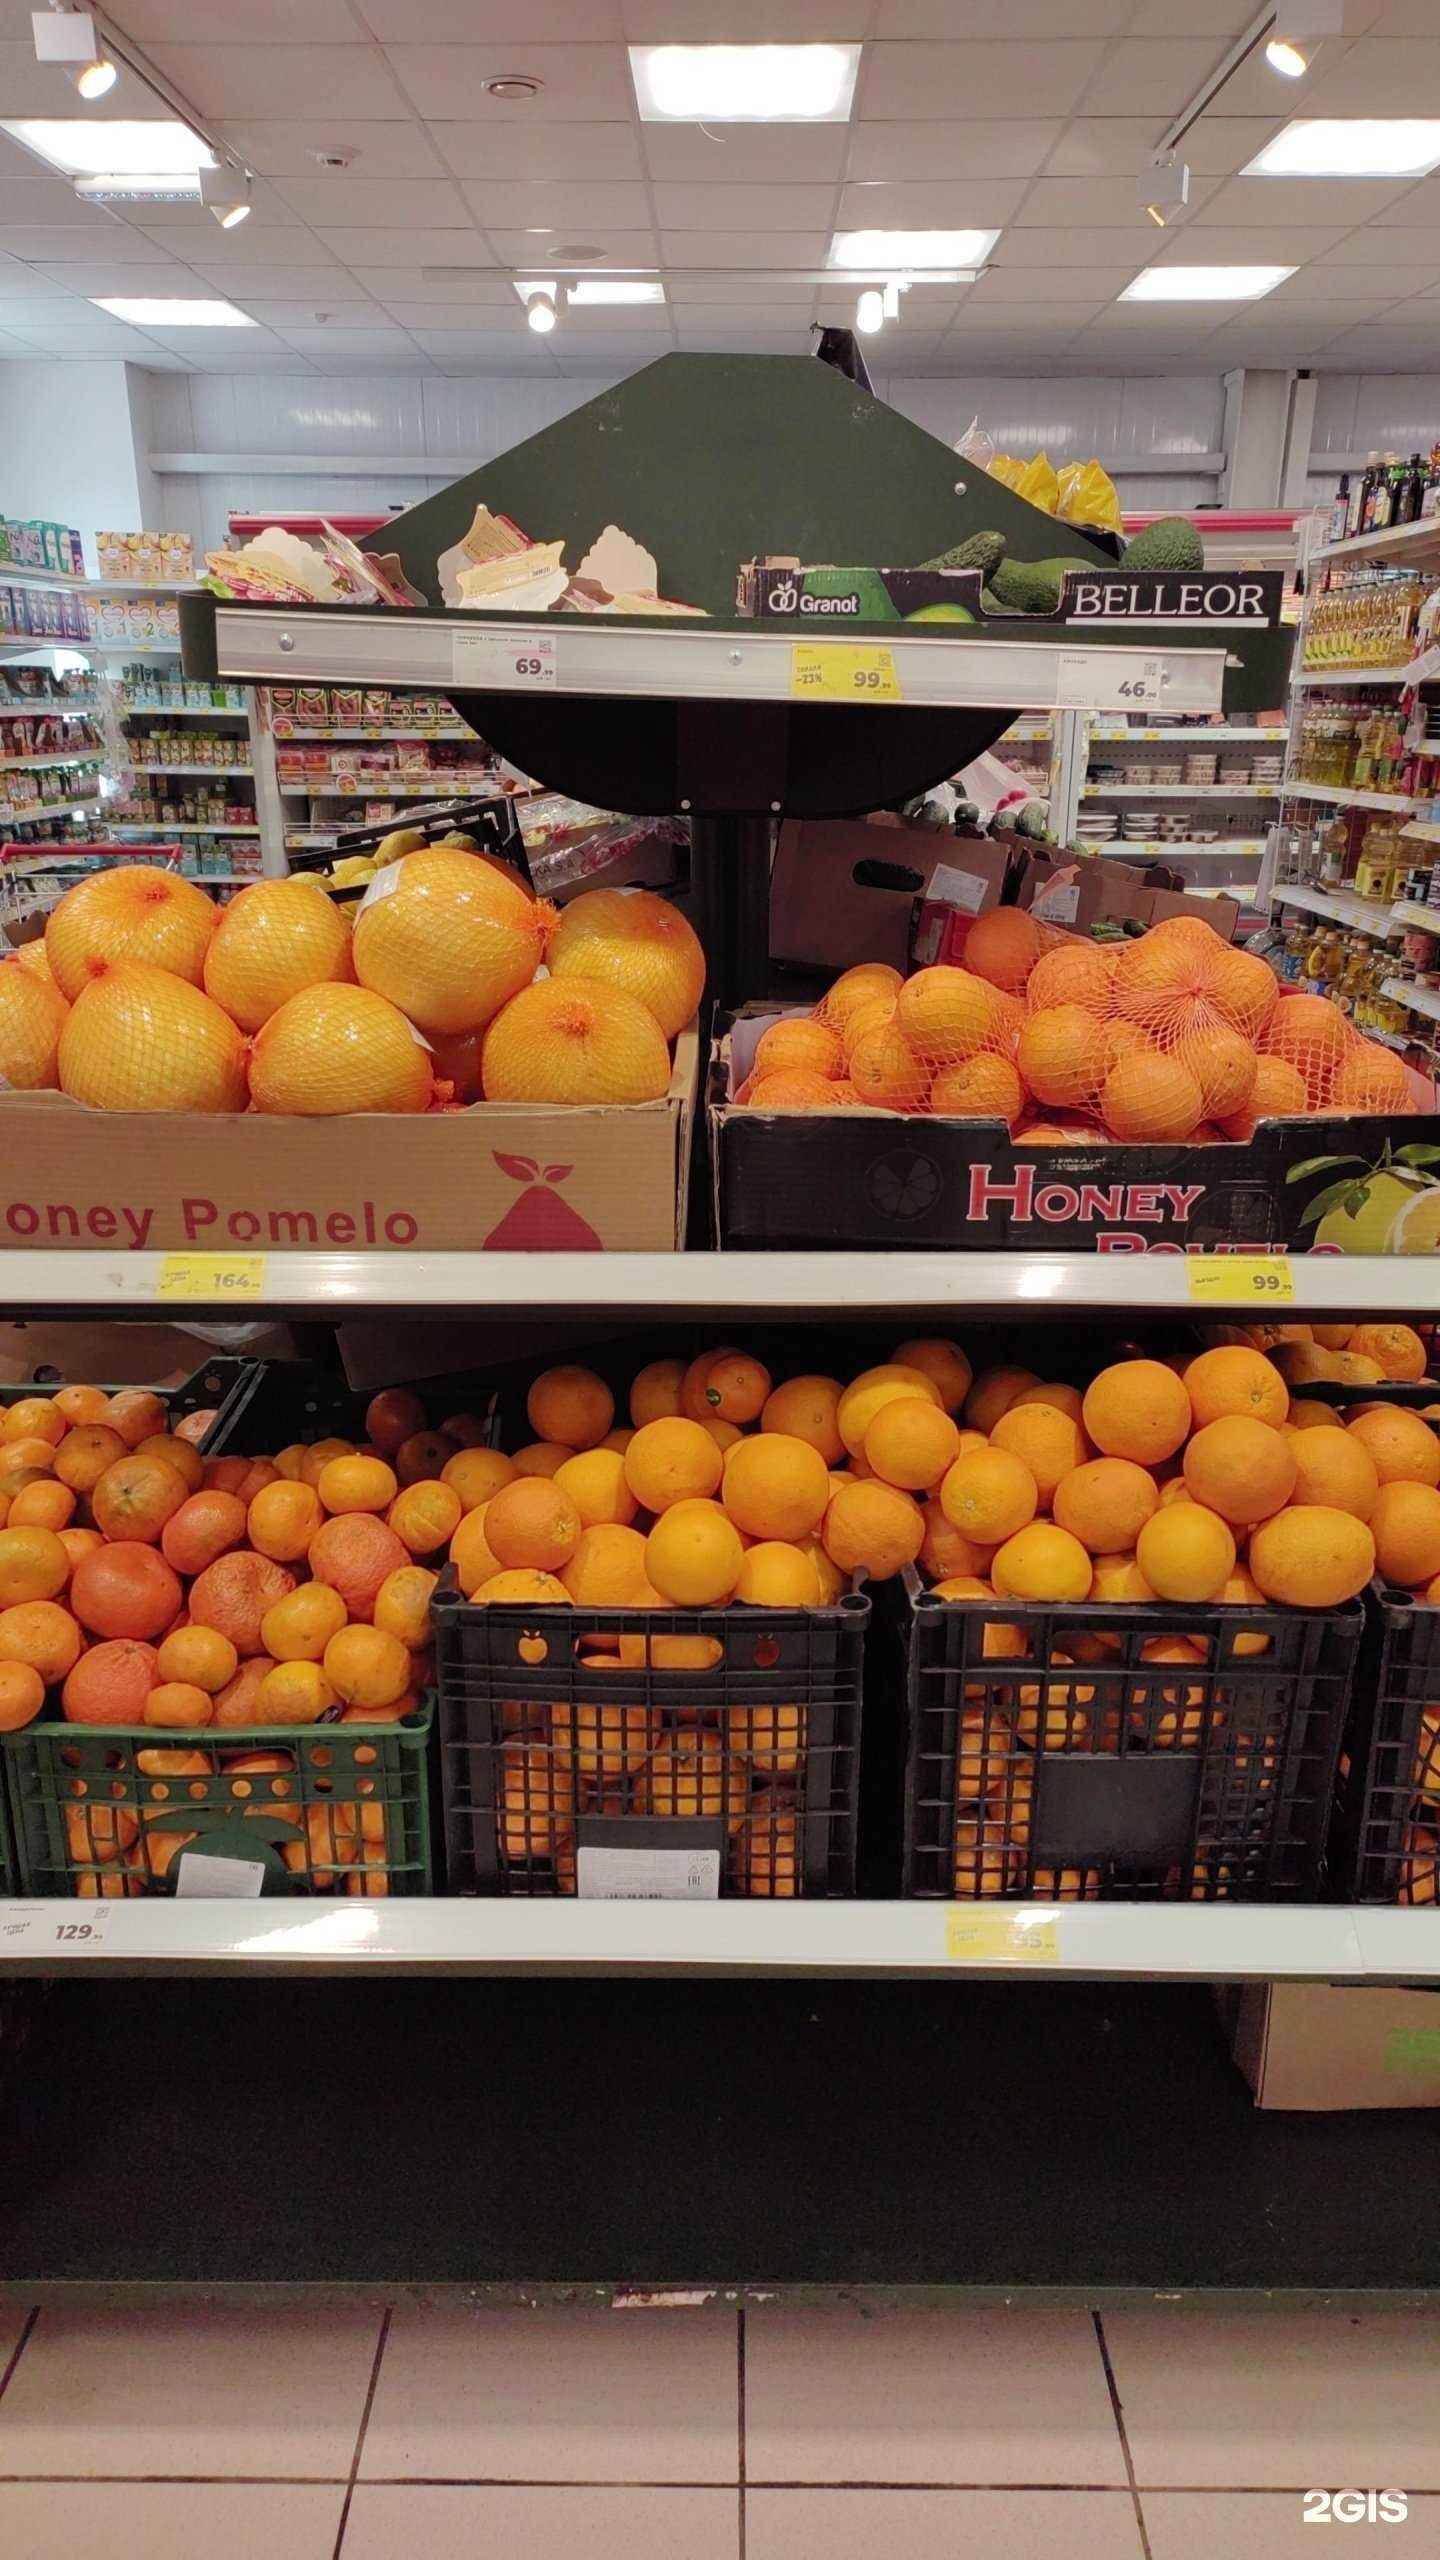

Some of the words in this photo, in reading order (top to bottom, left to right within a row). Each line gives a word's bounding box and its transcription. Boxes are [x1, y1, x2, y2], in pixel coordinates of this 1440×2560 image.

[800, 595, 858, 613] Granot
[1073, 584, 1264, 616] BELLEOR
[515, 658, 542, 675] 69
[853, 671, 880, 688] 99
[1117, 680, 1146, 697] 46
[966, 1164, 1205, 1223] HONEY
[5, 1202, 154, 1250] oney
[181, 1198, 418, 1245] Pomelo
[1252, 1275, 1280, 1290] 99
[55, 1924, 93, 1940] 129
